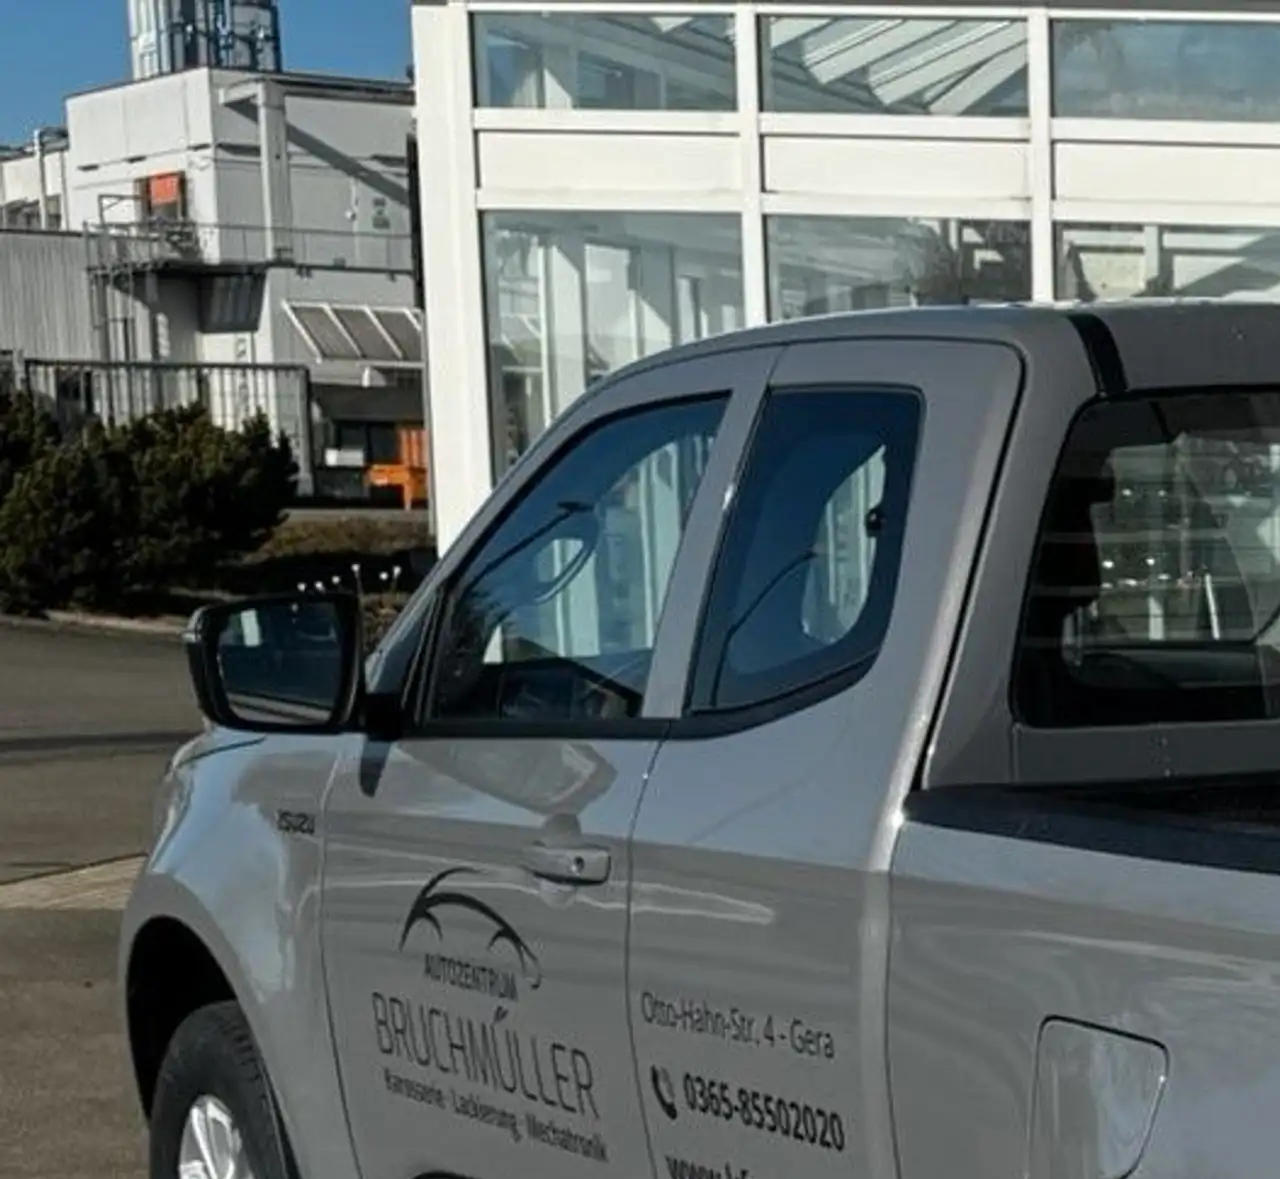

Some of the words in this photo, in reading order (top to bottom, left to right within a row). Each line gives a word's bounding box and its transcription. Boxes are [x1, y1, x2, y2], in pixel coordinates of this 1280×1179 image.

[763, 1014, 775, 1048] 4
[790, 1016, 835, 1058] Gera
[683, 1071, 845, 1151] 0365-85502020
